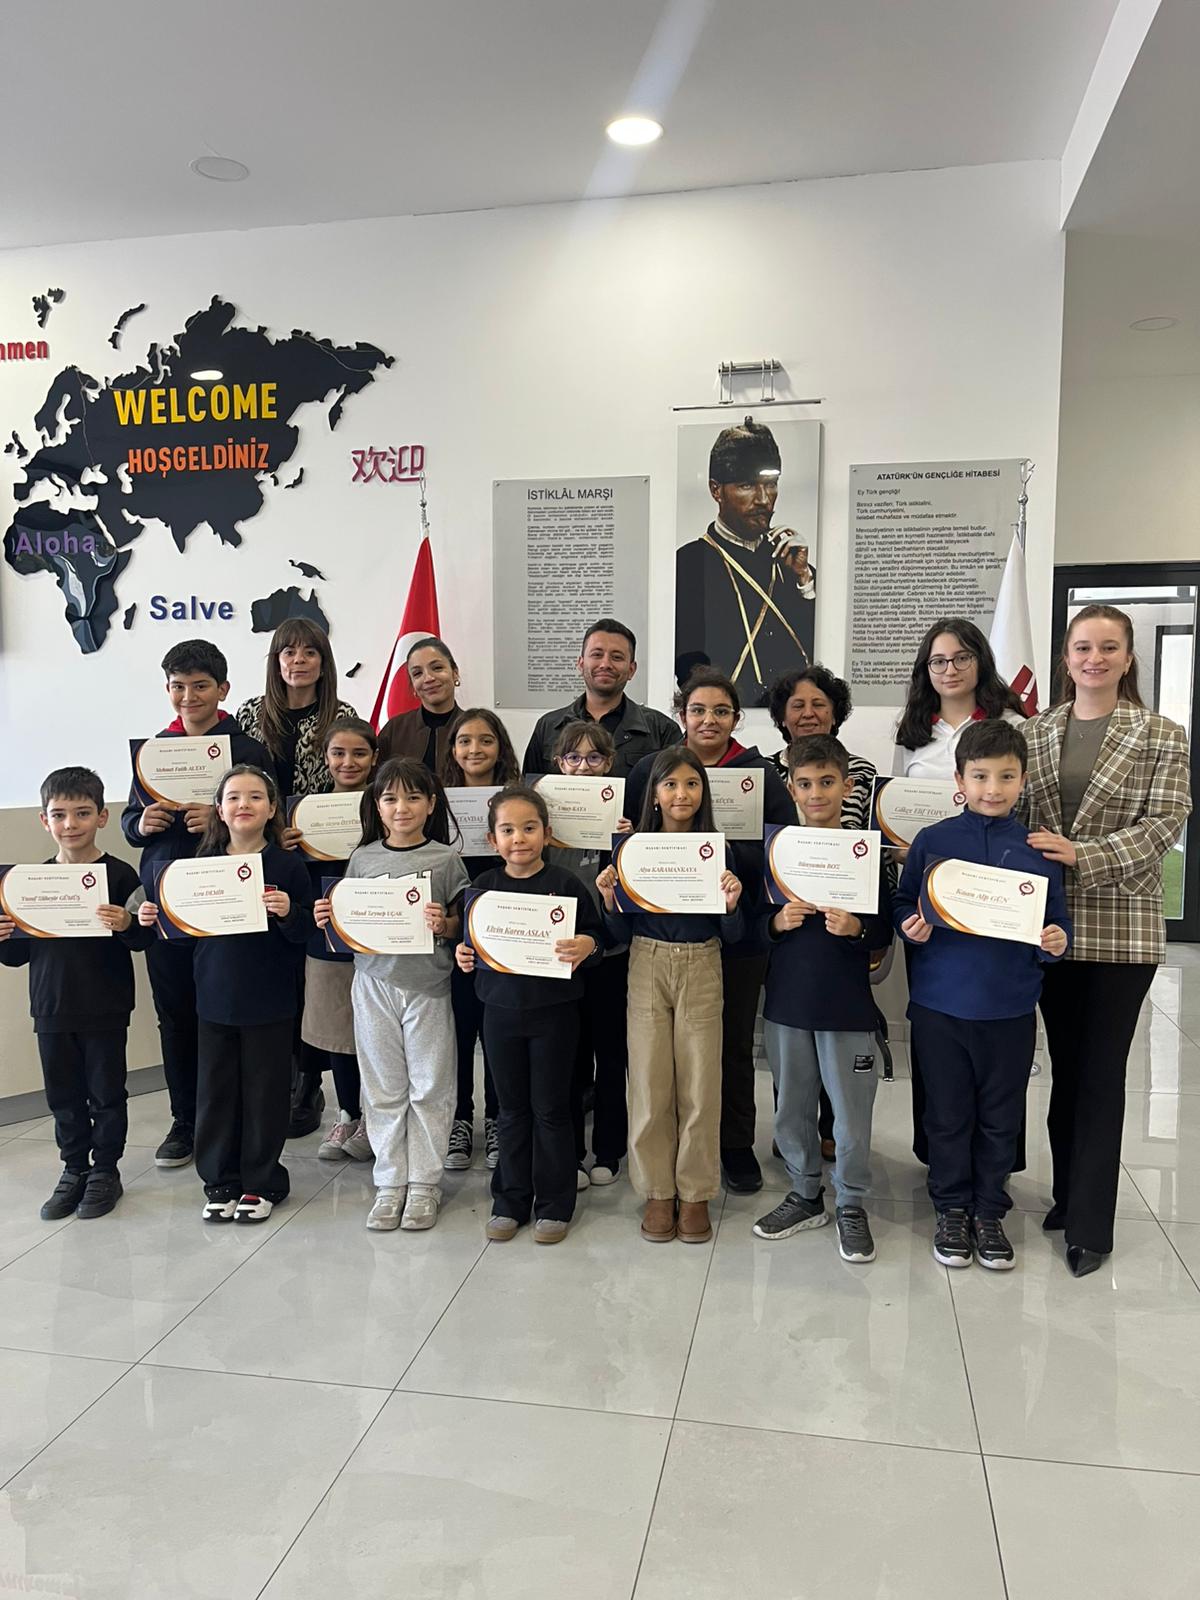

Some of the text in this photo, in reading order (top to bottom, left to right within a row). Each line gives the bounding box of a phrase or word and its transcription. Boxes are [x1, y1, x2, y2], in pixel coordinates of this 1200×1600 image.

[114, 383, 277, 425] WELCOME
[128, 437, 269, 478] HOŞGELDİNİZ
[351, 445, 424, 483] 欢迎
[877, 468, 1000, 480] ATATÜRK'ÜN GENÇLİĞE HİTABESİ
[578, 488, 613, 500] MARŞI
[15, 531, 96, 554] Aloha
[150, 596, 234, 620] Salve
